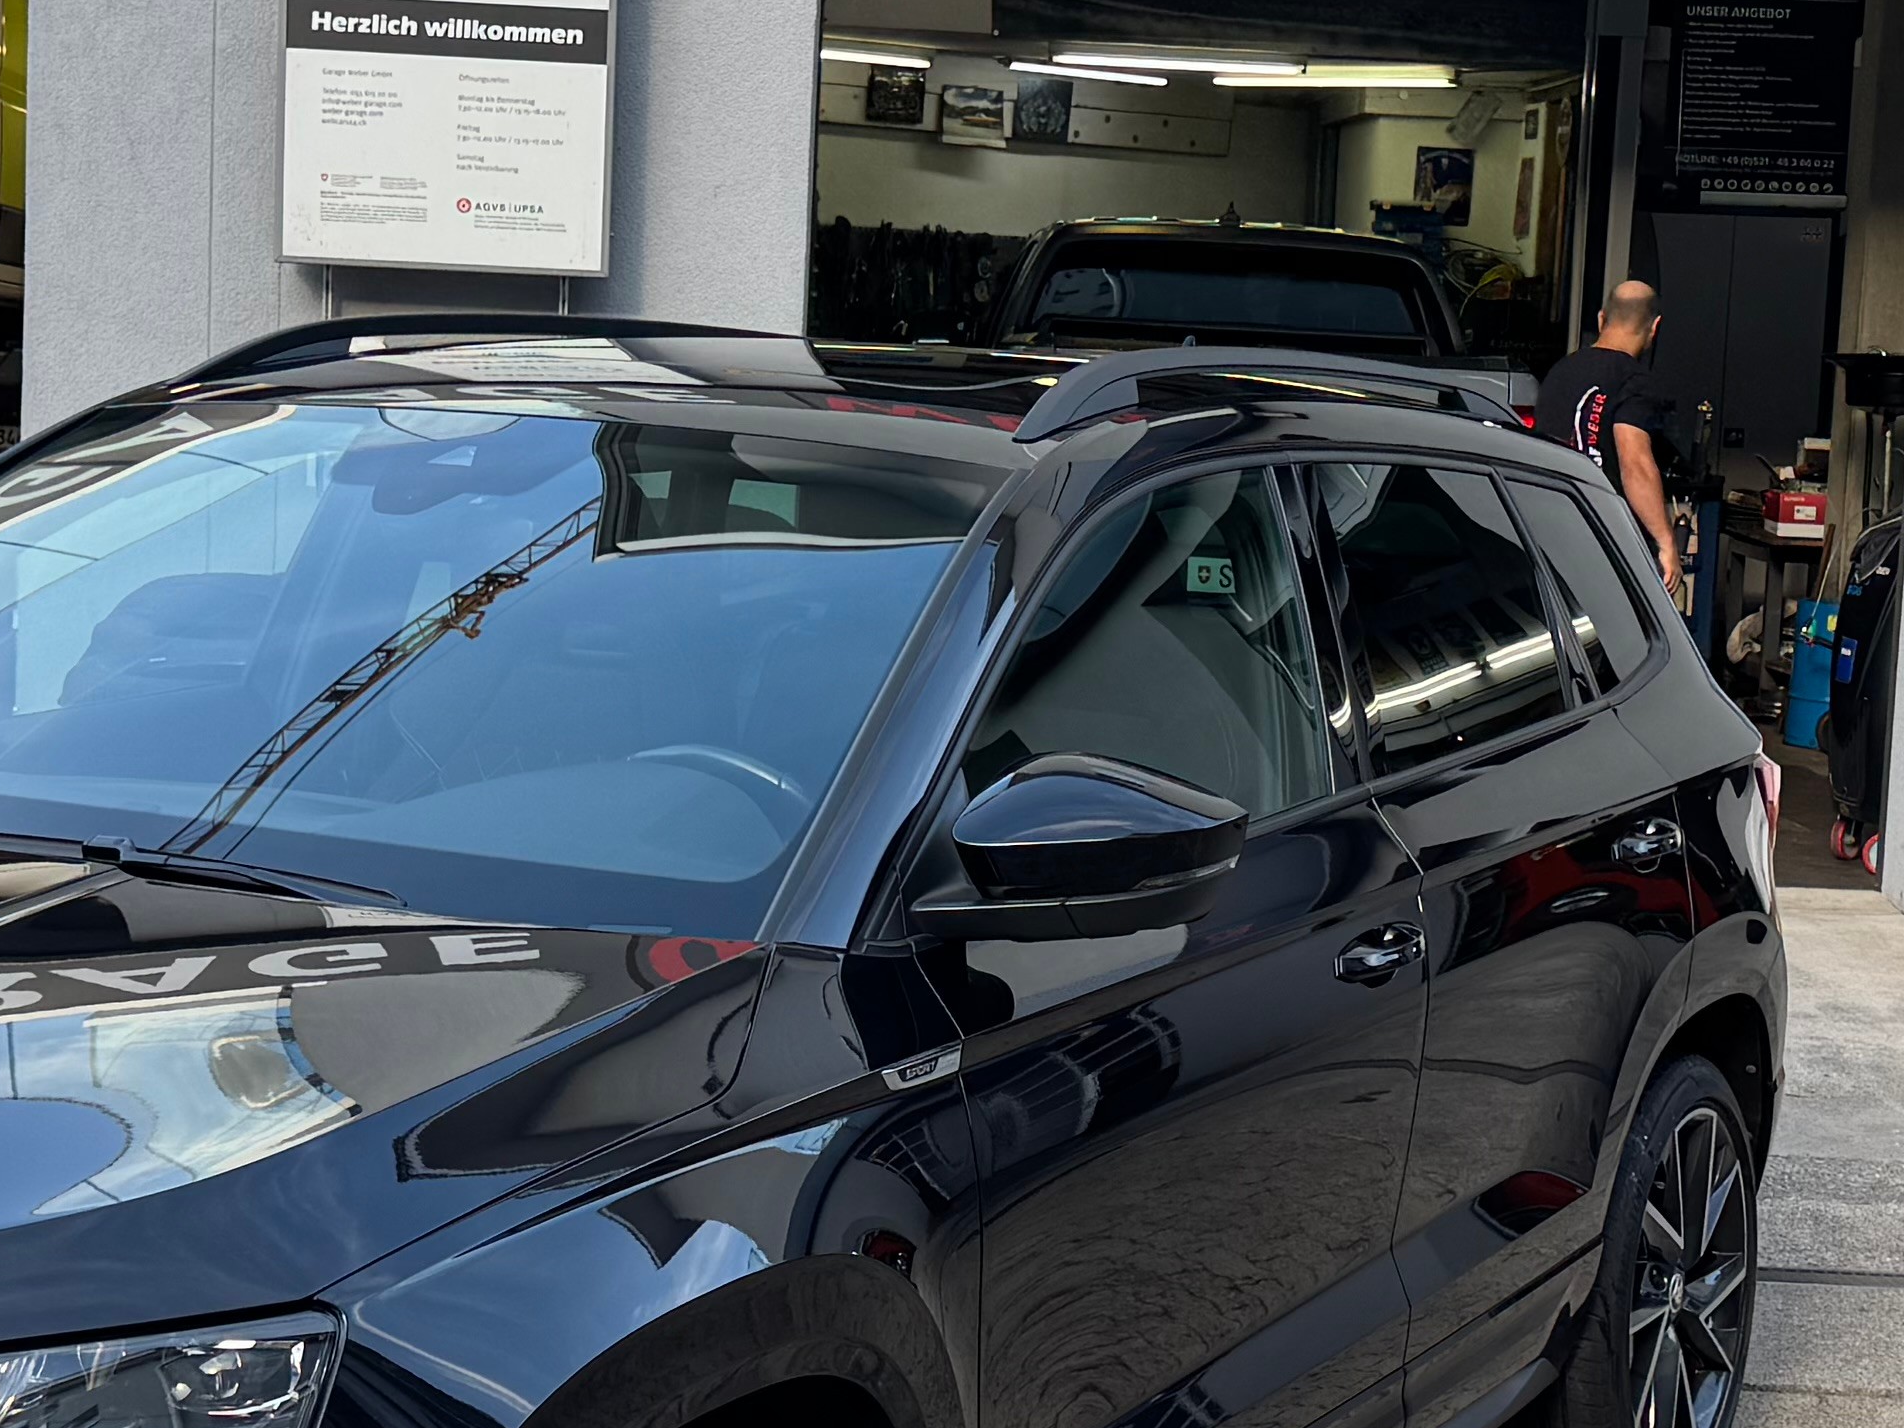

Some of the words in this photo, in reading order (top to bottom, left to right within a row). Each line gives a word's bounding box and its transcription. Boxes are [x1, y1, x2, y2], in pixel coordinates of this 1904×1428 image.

[1686, 5, 1728, 17] UNSER
[1732, 7, 1791, 20] ANGEBOT
[311, 10, 417, 38] Herzlich
[425, 17, 584, 45] willkommen
